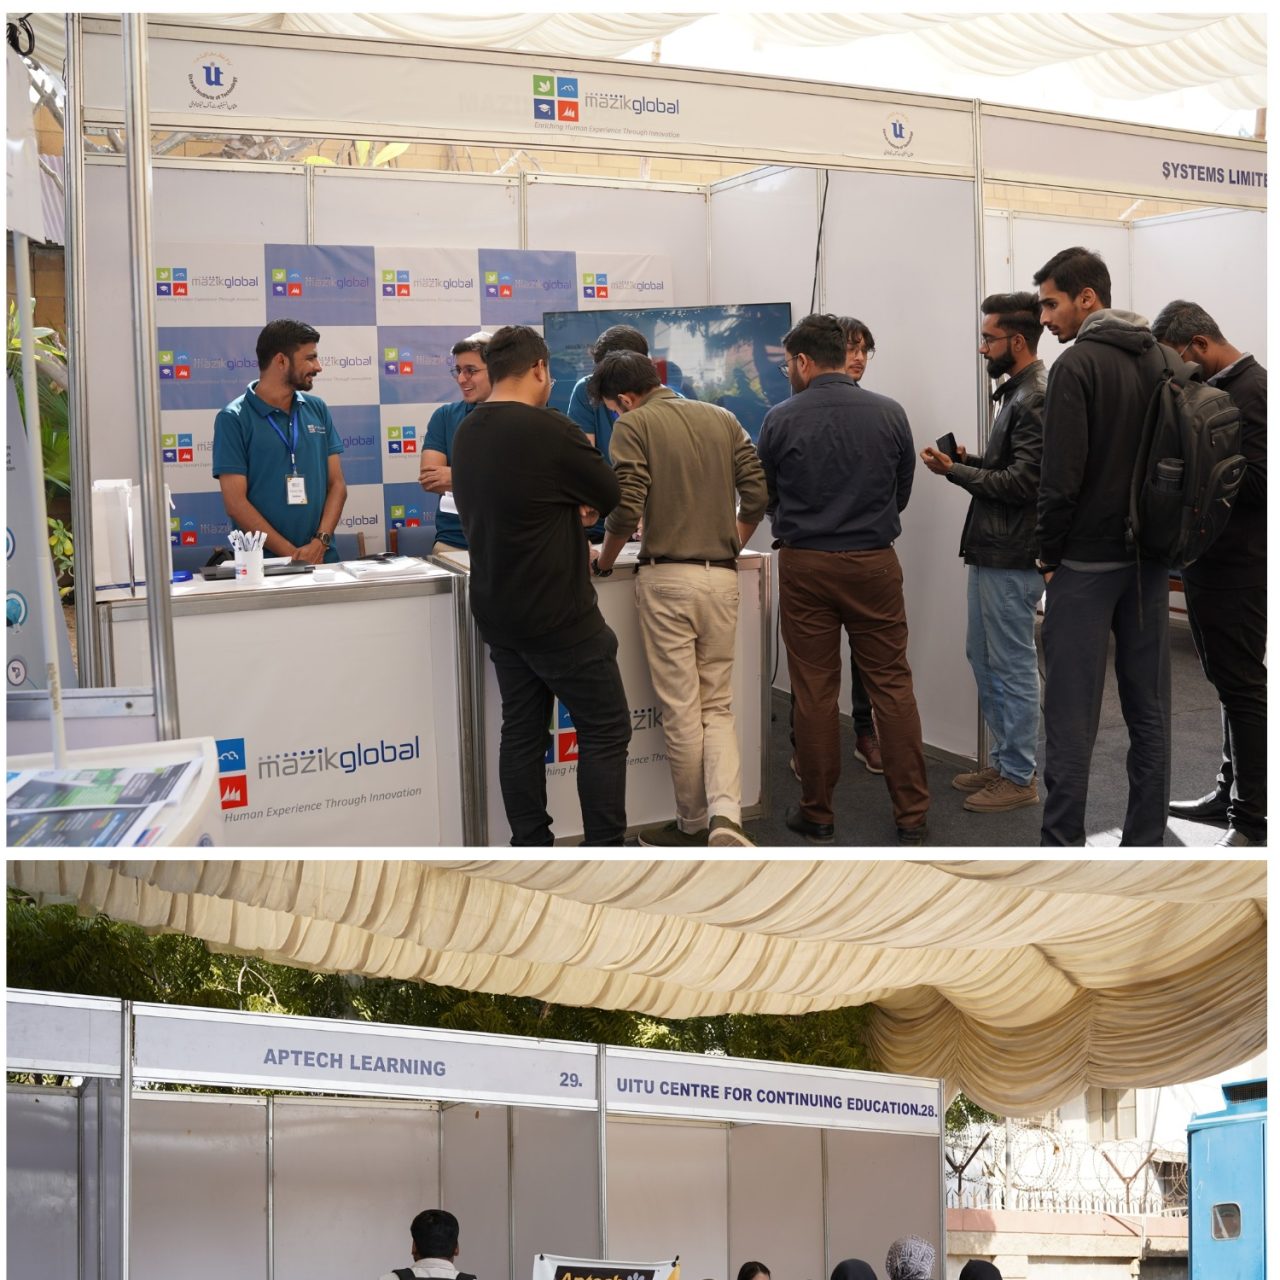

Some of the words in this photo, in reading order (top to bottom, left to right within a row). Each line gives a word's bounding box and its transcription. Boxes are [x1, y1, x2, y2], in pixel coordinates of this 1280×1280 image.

[585, 92, 679, 115] mazikglobal
[534, 122, 563, 131] Enriching
[565, 124, 587, 132] Human
[589, 125, 621, 135] Experience
[623, 127, 648, 136] Through
[1162, 161, 1224, 183] SYSTEMS
[258, 736, 420, 779] mazikglobal
[224, 809, 263, 823] Human
[266, 801, 322, 818] Experience
[325, 793, 367, 809] Through
[370, 787, 422, 803] Innovation
[263, 1048, 343, 1069] APTECH
[349, 1054, 446, 1077] LEARNING
[559, 1071, 583, 1088] 29.
[616, 1077, 655, 1094] UITU
[659, 1081, 720, 1099] CENTRE
[724, 1086, 752, 1102] FOR
[756, 1089, 843, 1109] CONTINUING
